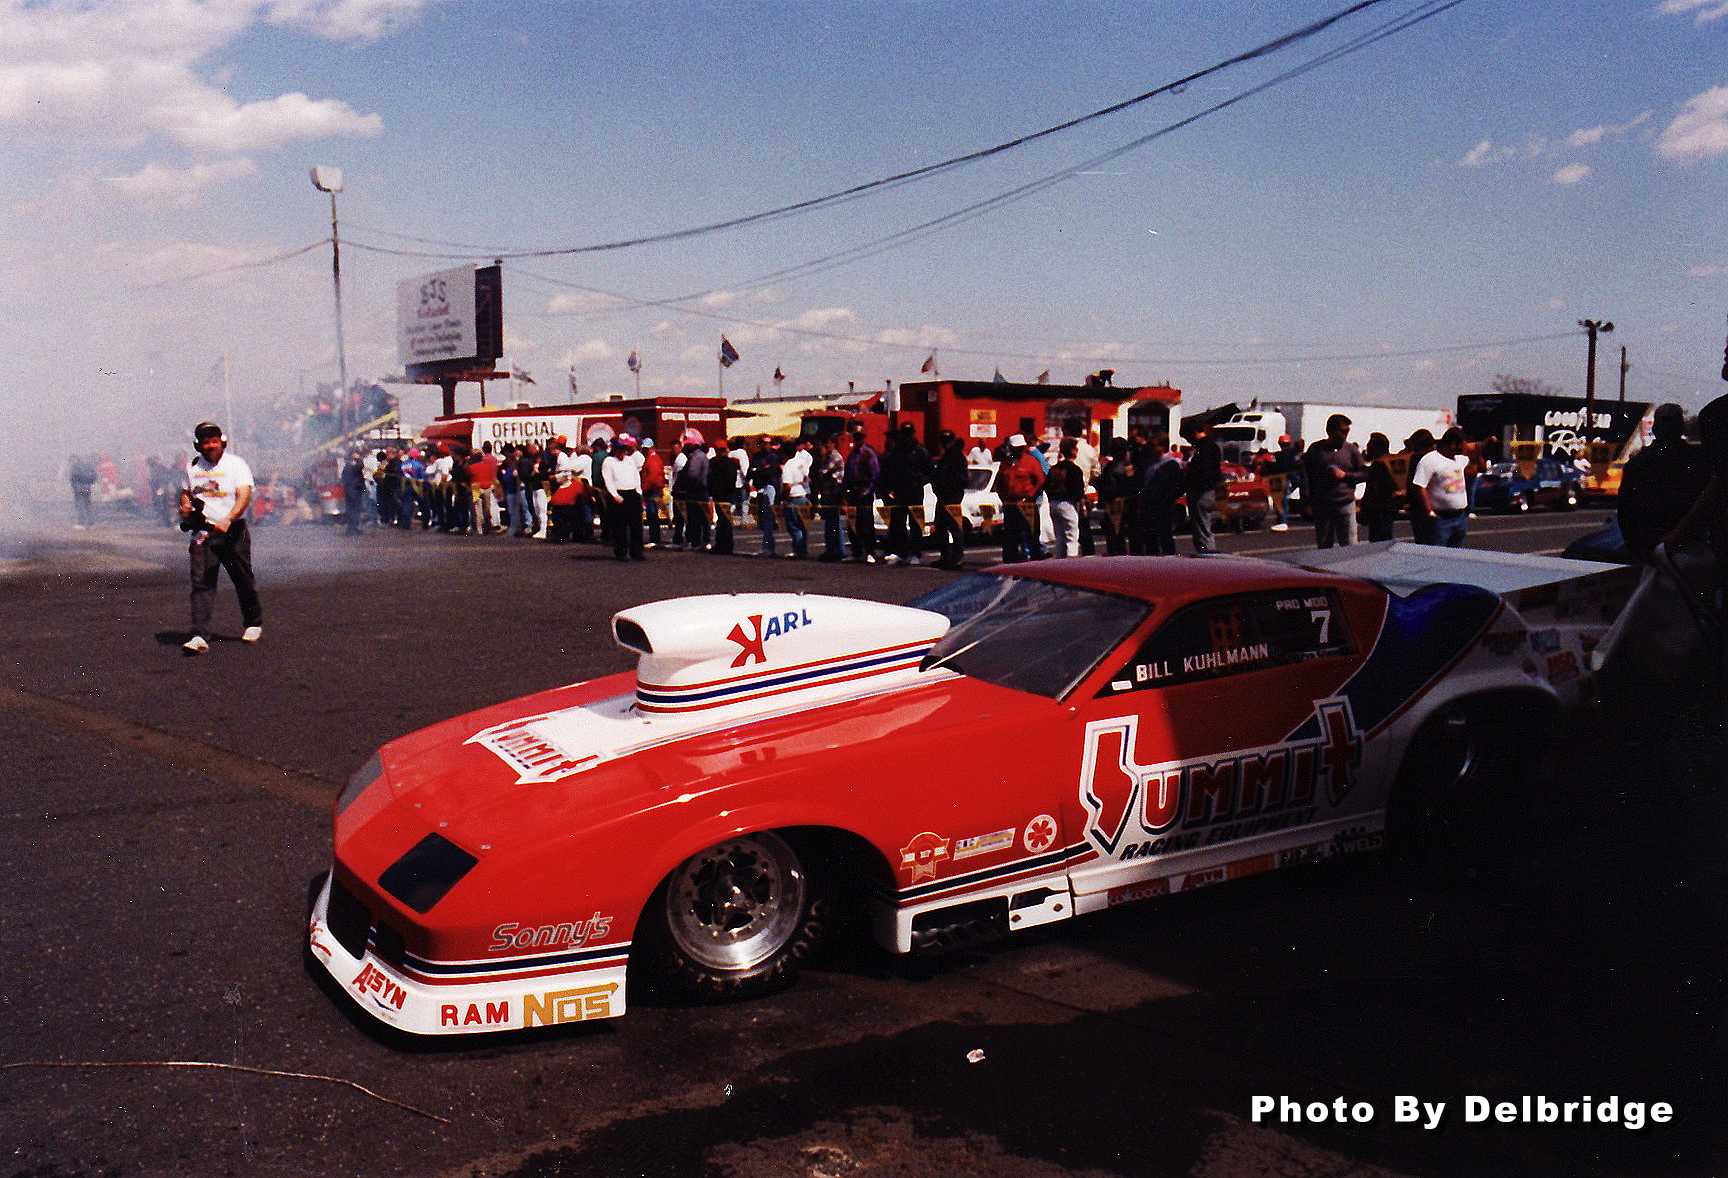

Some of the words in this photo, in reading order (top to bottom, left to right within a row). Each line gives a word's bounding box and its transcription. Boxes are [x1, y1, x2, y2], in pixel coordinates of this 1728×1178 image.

[492, 421, 556, 438] OFFICIAL
[1275, 598, 1301, 611] PRO
[1304, 596, 1328, 609] MOD
[727, 608, 812, 668] KARL
[1310, 610, 1331, 644] 7
[1136, 663, 1173, 682] BILL
[1183, 643, 1269, 673] KUHLMANN
[1120, 831, 1199, 861] RACING
[489, 911, 612, 951] Sonny's
[441, 1000, 509, 1027] RAM
